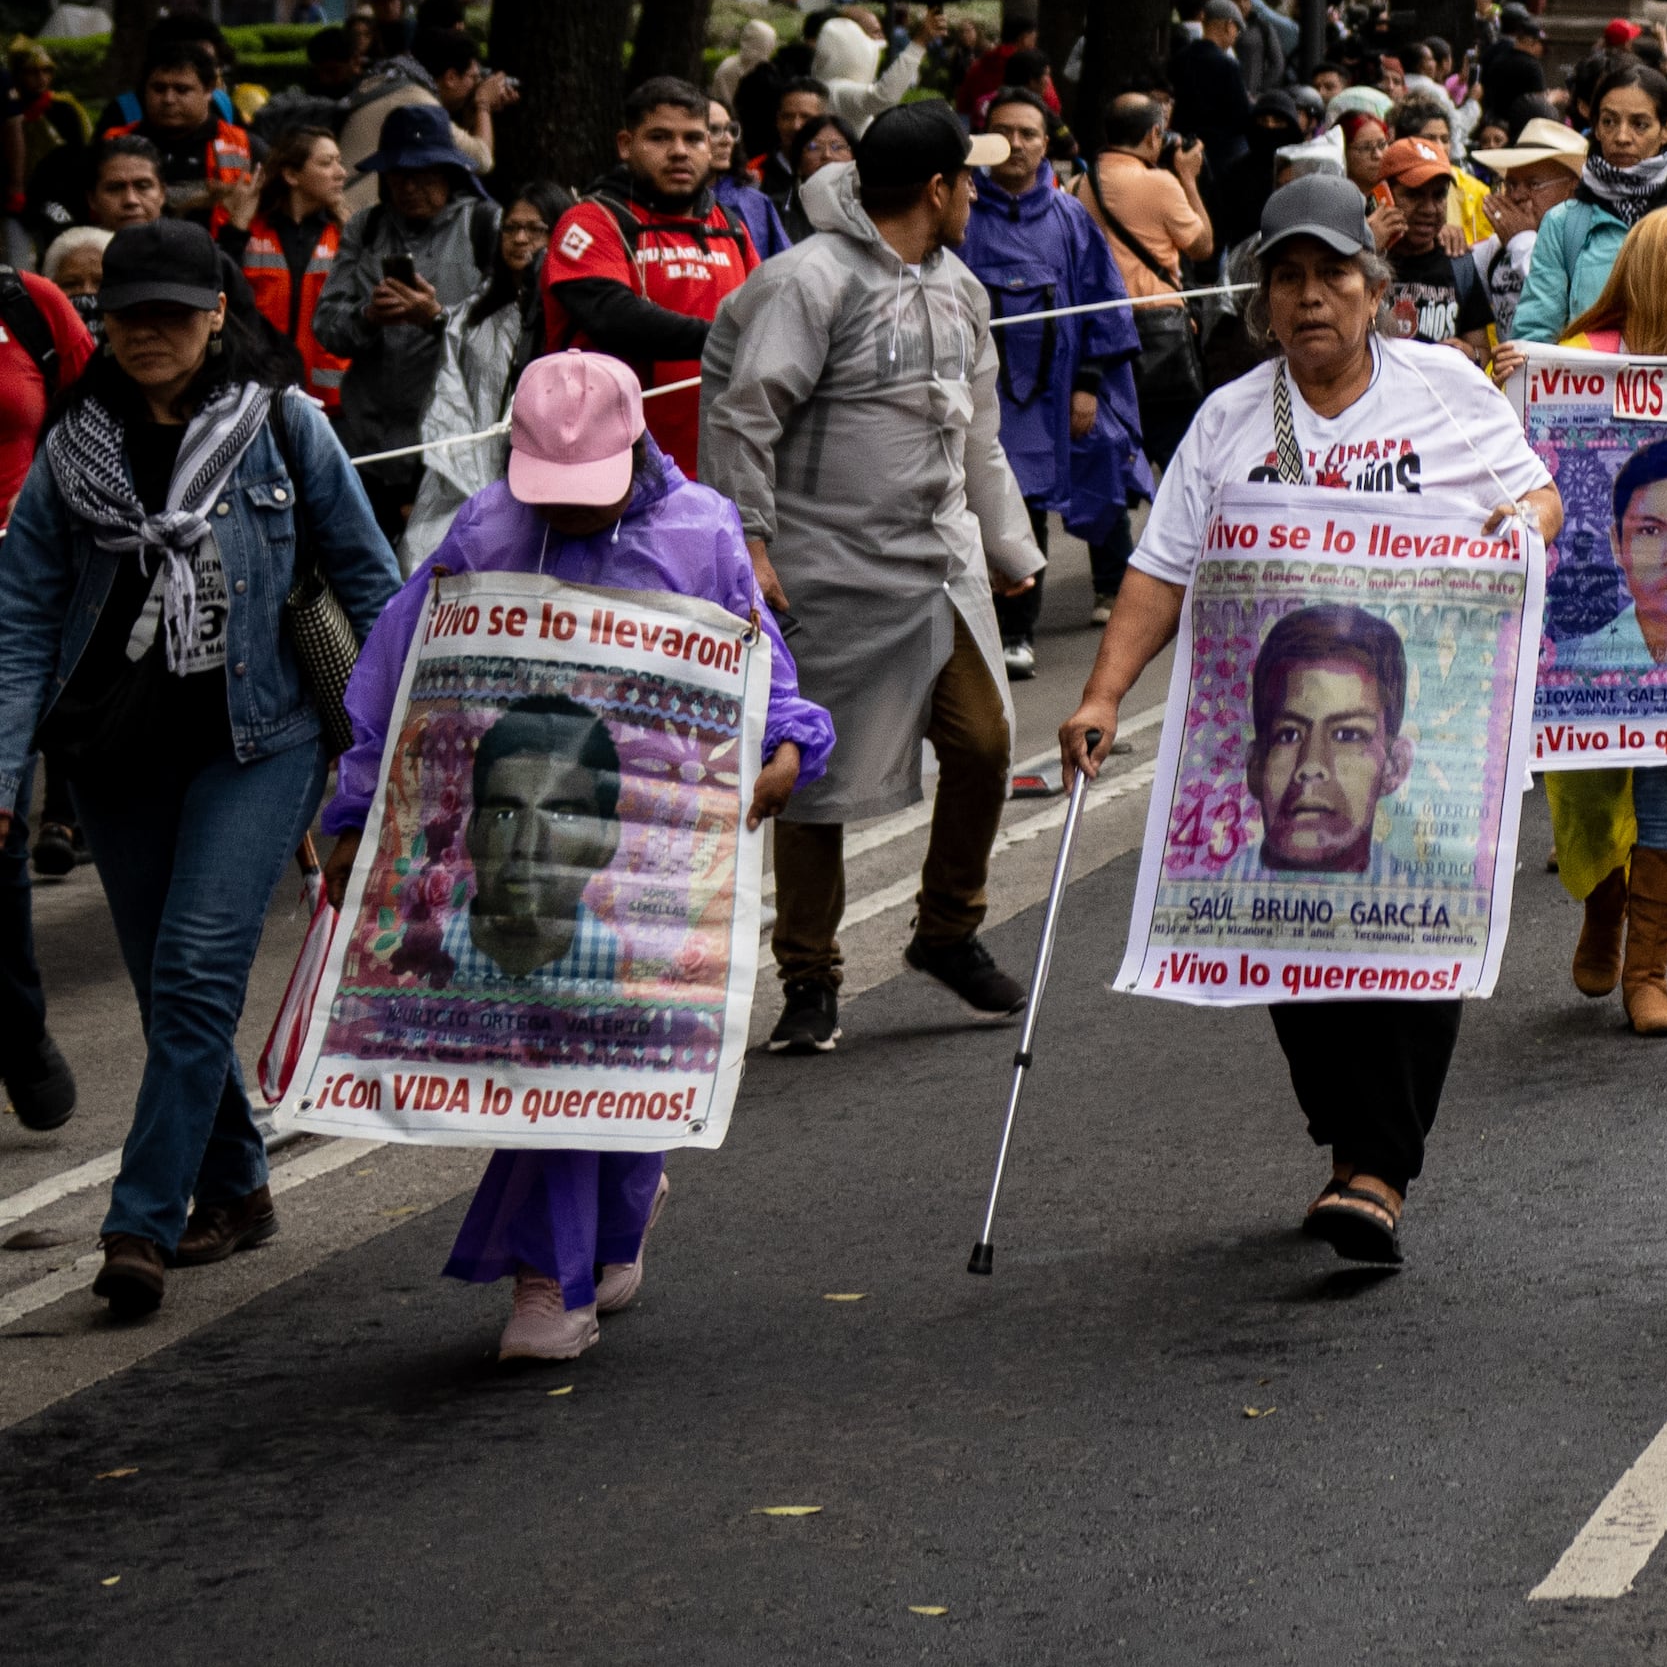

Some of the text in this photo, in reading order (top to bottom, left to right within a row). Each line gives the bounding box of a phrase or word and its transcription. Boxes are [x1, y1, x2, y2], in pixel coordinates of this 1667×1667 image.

[1530, 368, 1605, 402] ¡Vivo
[1616, 369, 1664, 416] NOS
[1268, 520, 1522, 562] se lo llevaron!
[424, 601, 743, 675] ¡Vivo se lo llevaron!
[1534, 688, 1616, 705] GIOVANNI
[1536, 725, 1609, 758] ¡Vivo
[1619, 724, 1645, 749] lo
[1186, 892, 1450, 929] SAÚL BRUNO GARCÍA
[1154, 952, 1462, 995] ¡Vivo lo queremos!
[480, 1013, 554, 1032] ORTEGA
[566, 1016, 651, 1035] VALERIO
[316, 1073, 698, 1124] ¡Con VIDA lo queremos!
